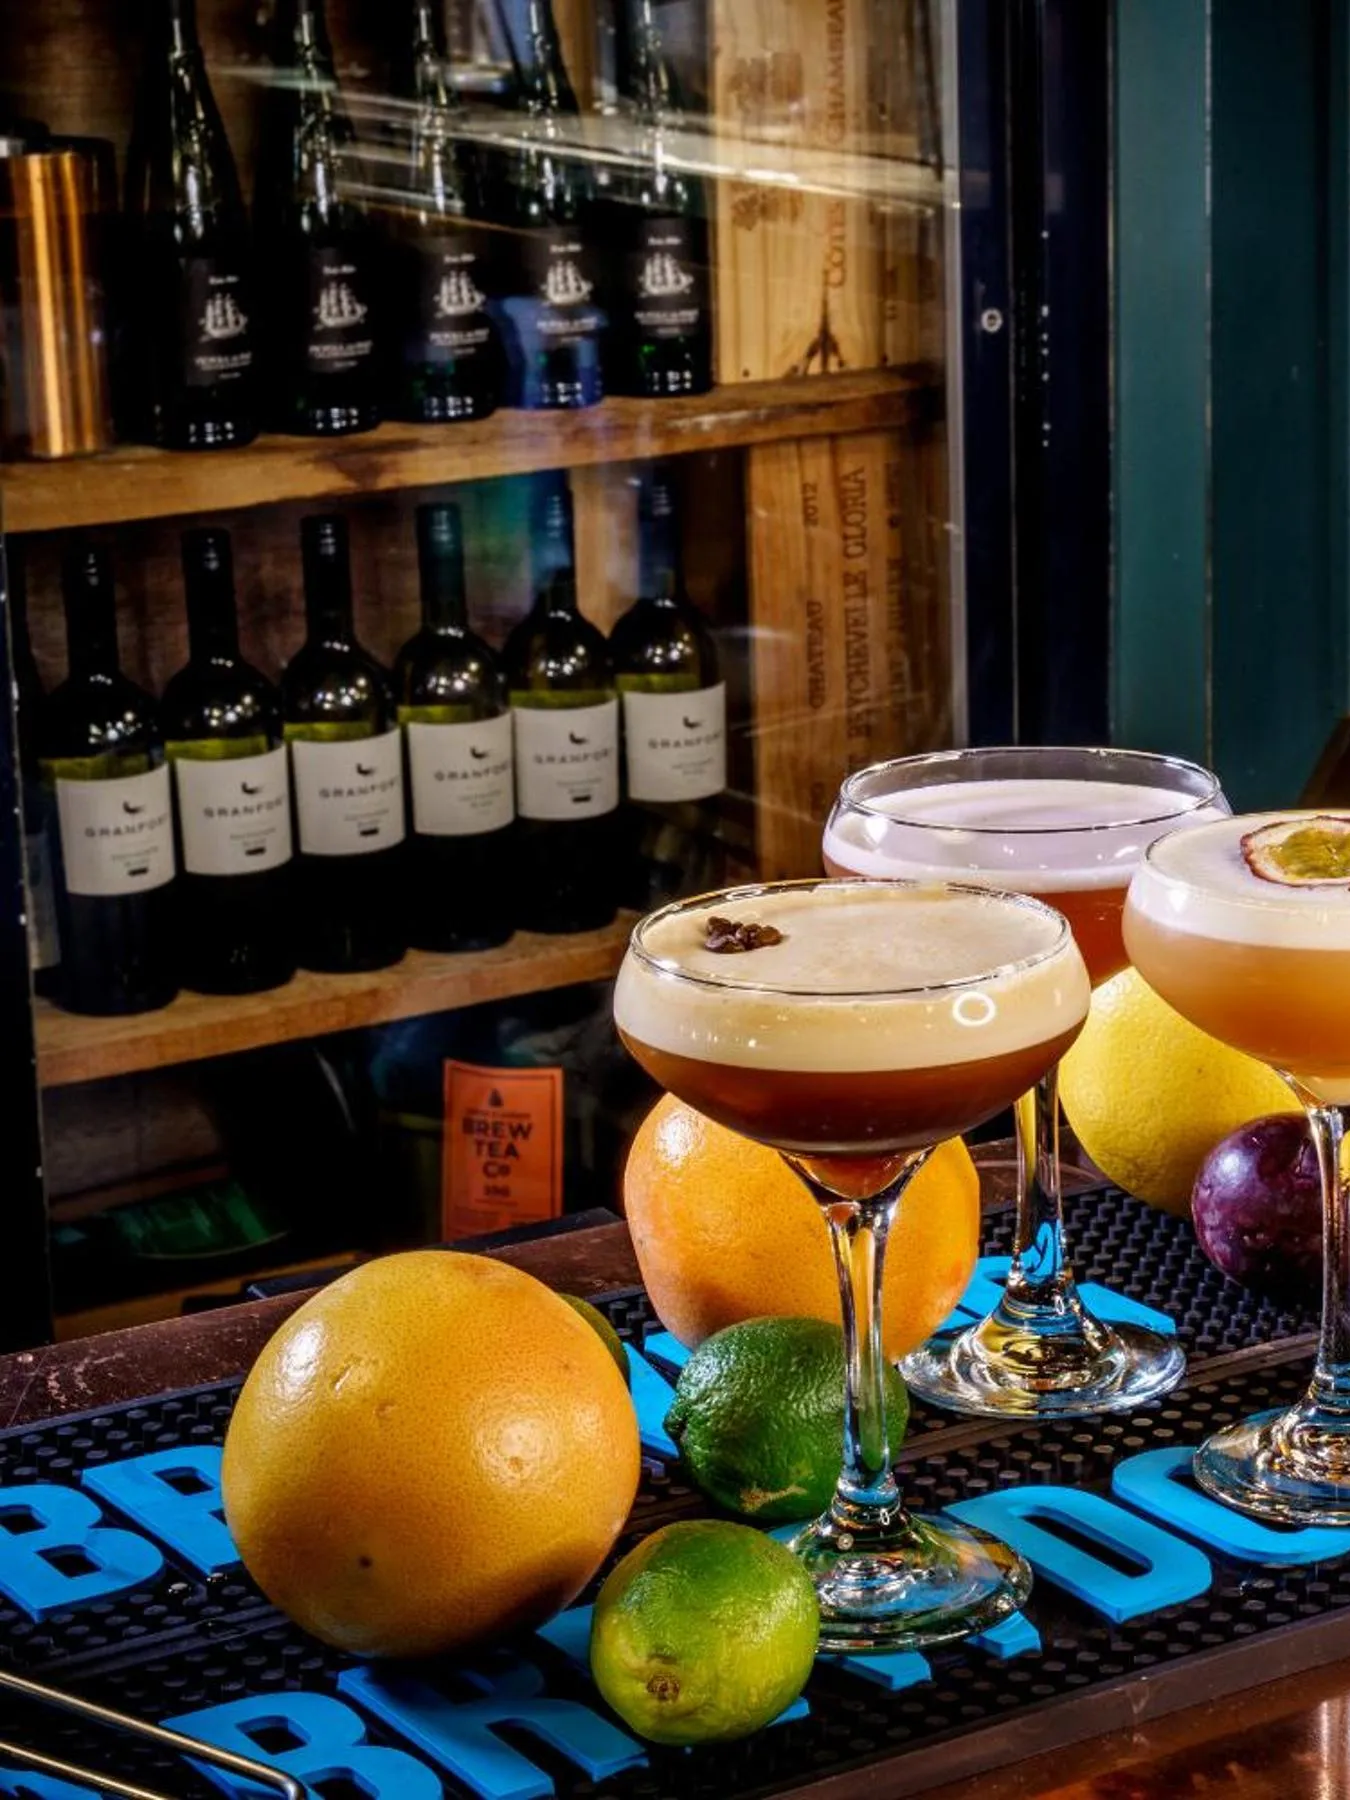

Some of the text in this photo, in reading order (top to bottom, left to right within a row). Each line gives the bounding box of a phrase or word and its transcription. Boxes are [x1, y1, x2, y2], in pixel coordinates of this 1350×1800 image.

[801, 482, 819, 527] 2012
[461, 1117, 533, 1140] BREW
[474, 1139, 520, 1160] TEA
